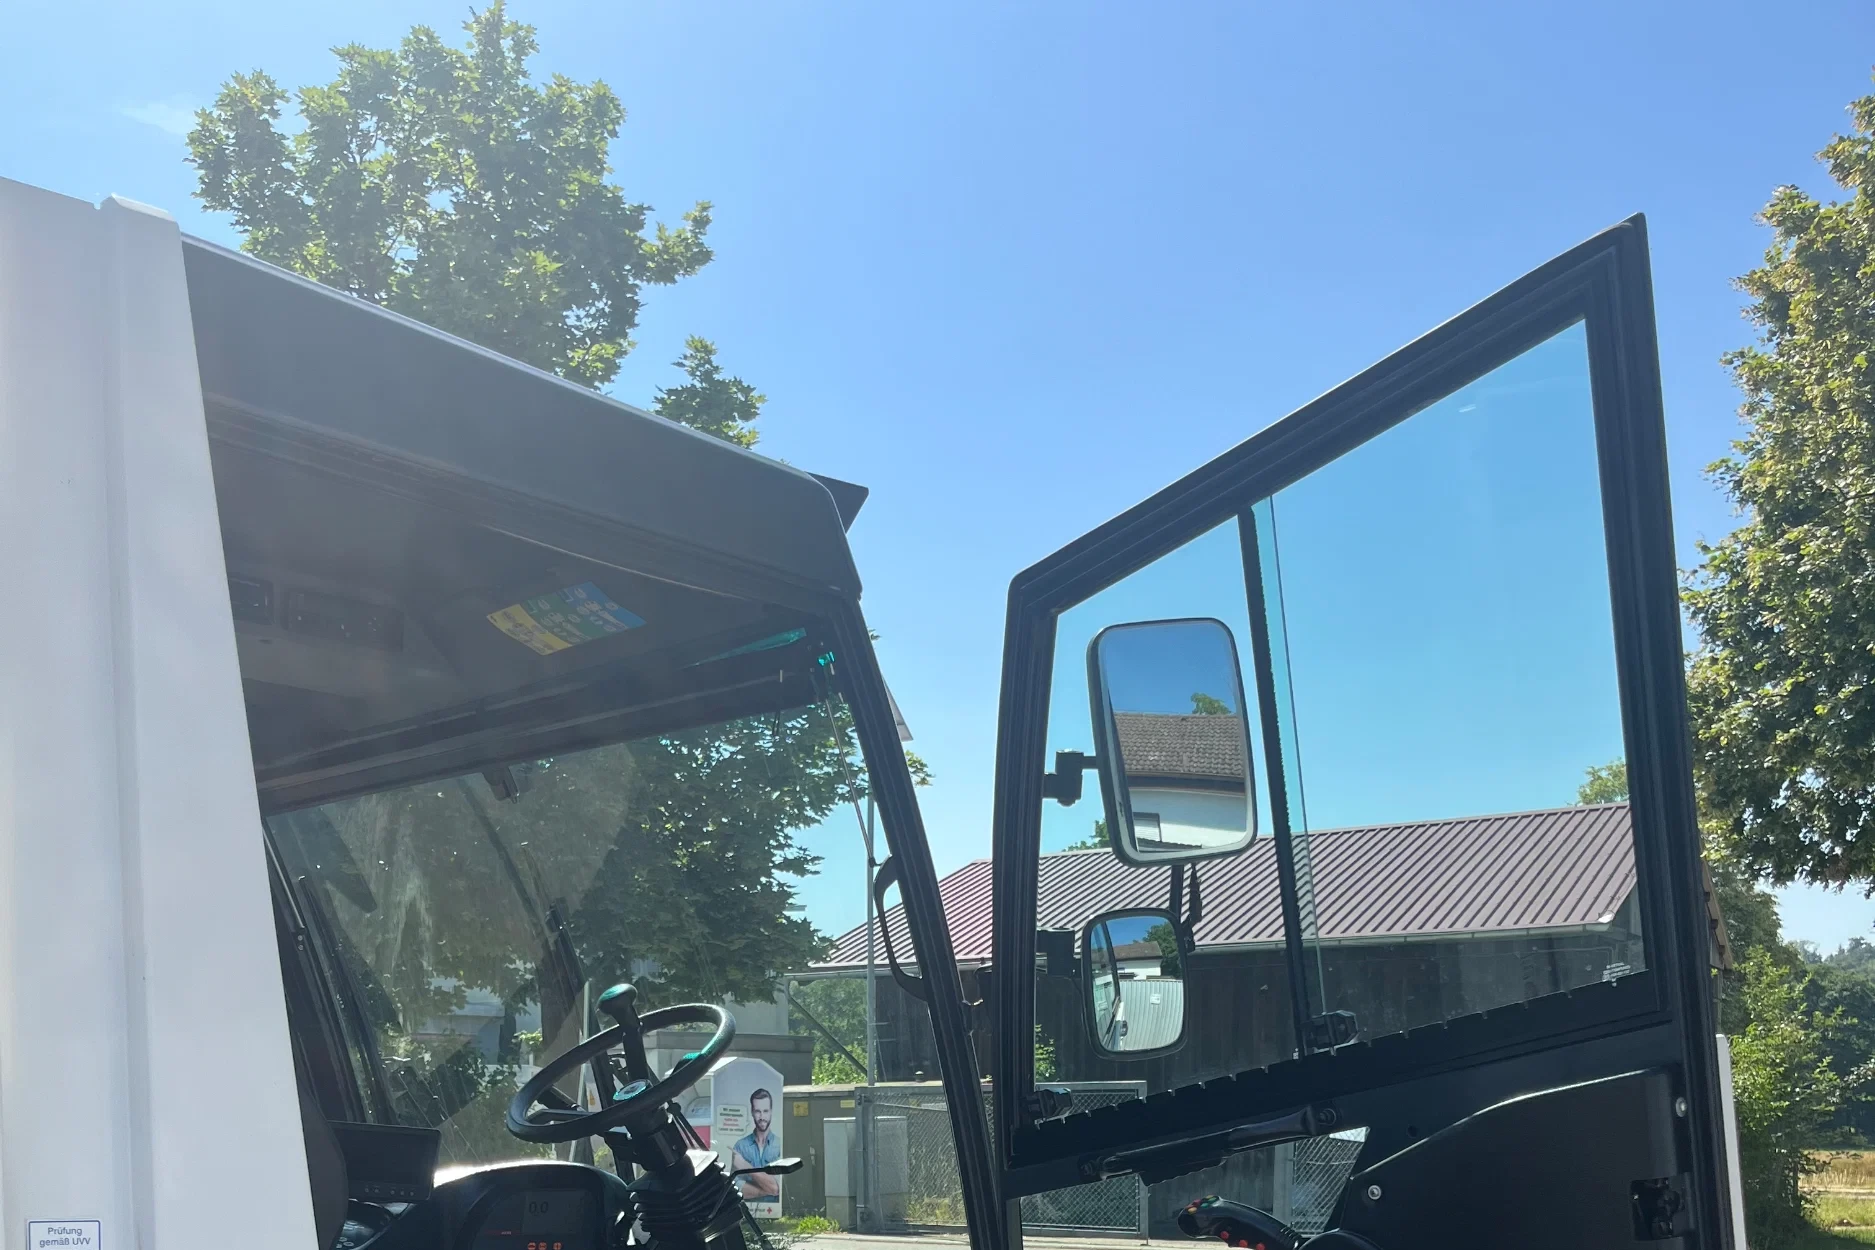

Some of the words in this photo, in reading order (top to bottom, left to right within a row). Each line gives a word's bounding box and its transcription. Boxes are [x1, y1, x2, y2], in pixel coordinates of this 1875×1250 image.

[47, 1227, 82, 1236] Prüfung
[40, 1238, 70, 1248] gemäß
[72, 1237, 91, 1245] UVV
